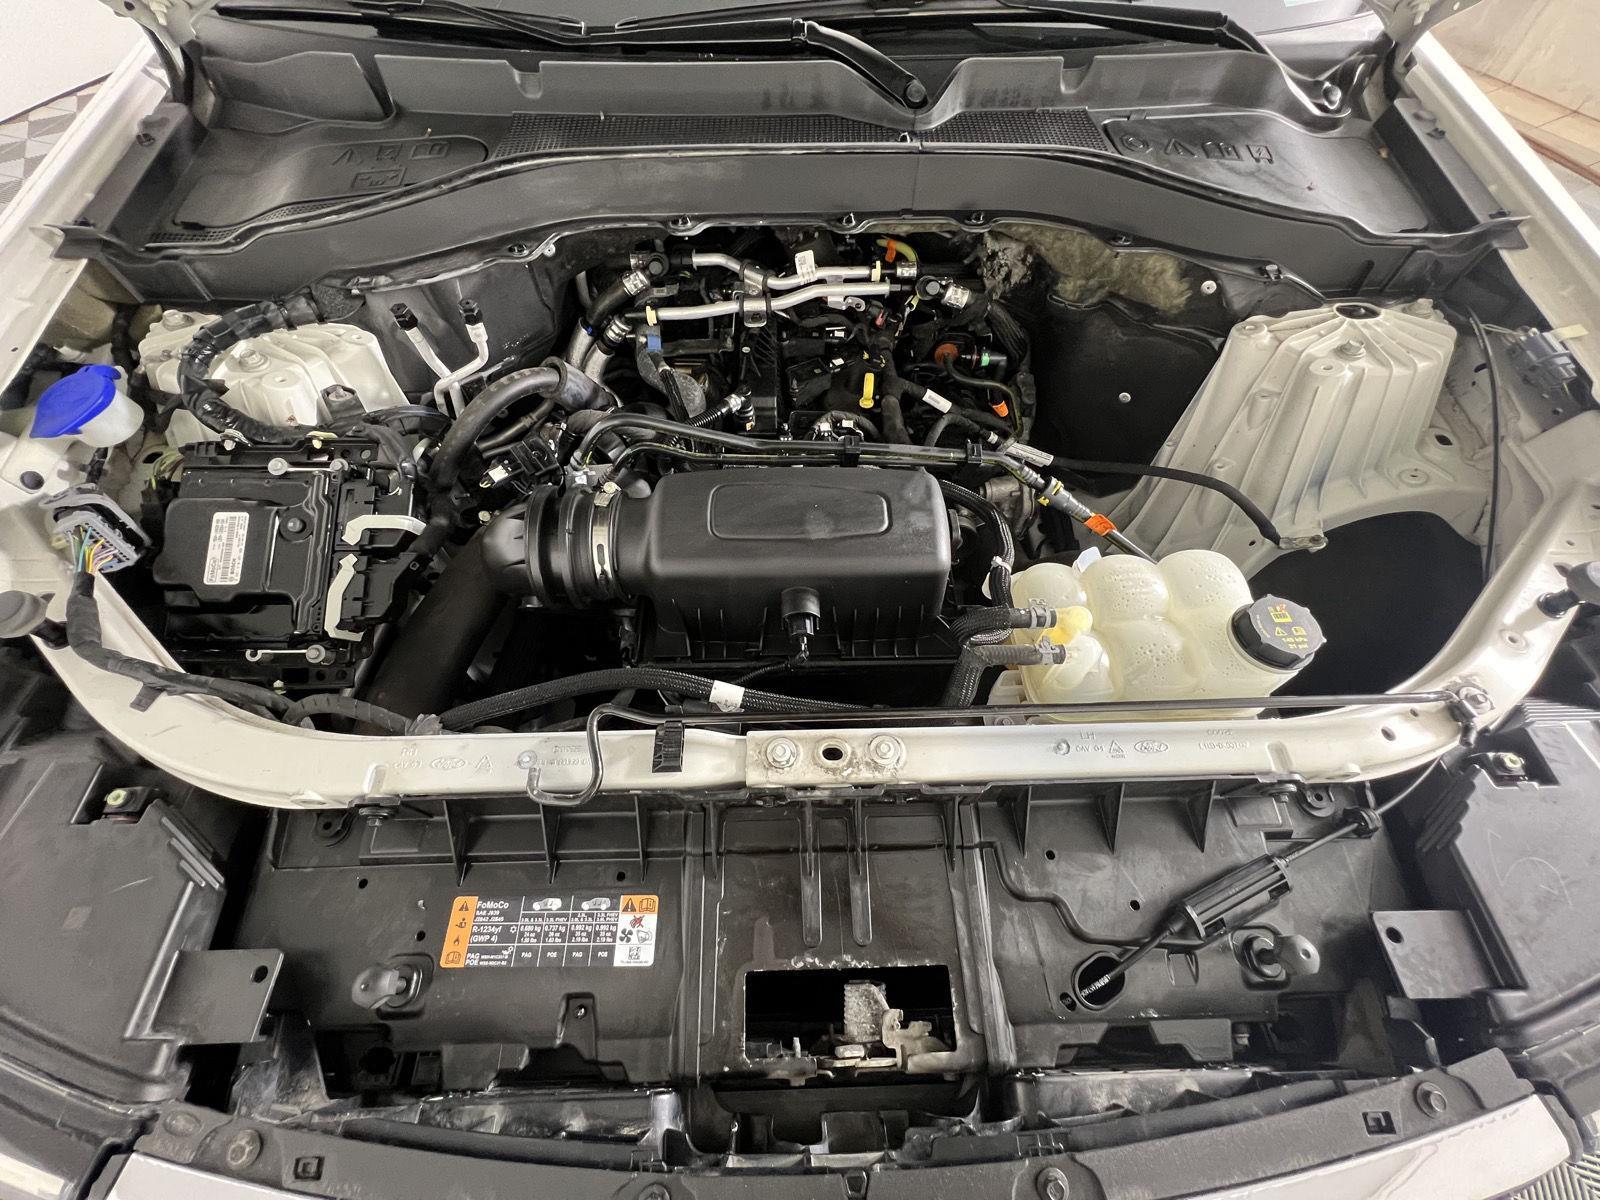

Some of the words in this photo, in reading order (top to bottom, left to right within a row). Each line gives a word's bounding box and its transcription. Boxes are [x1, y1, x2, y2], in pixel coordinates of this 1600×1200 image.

[476, 900, 510, 909] FoMoCo
[472, 925, 502, 934] R-1234yf
[470, 934, 490, 944] (GWP
[490, 934, 498, 944] 4)
